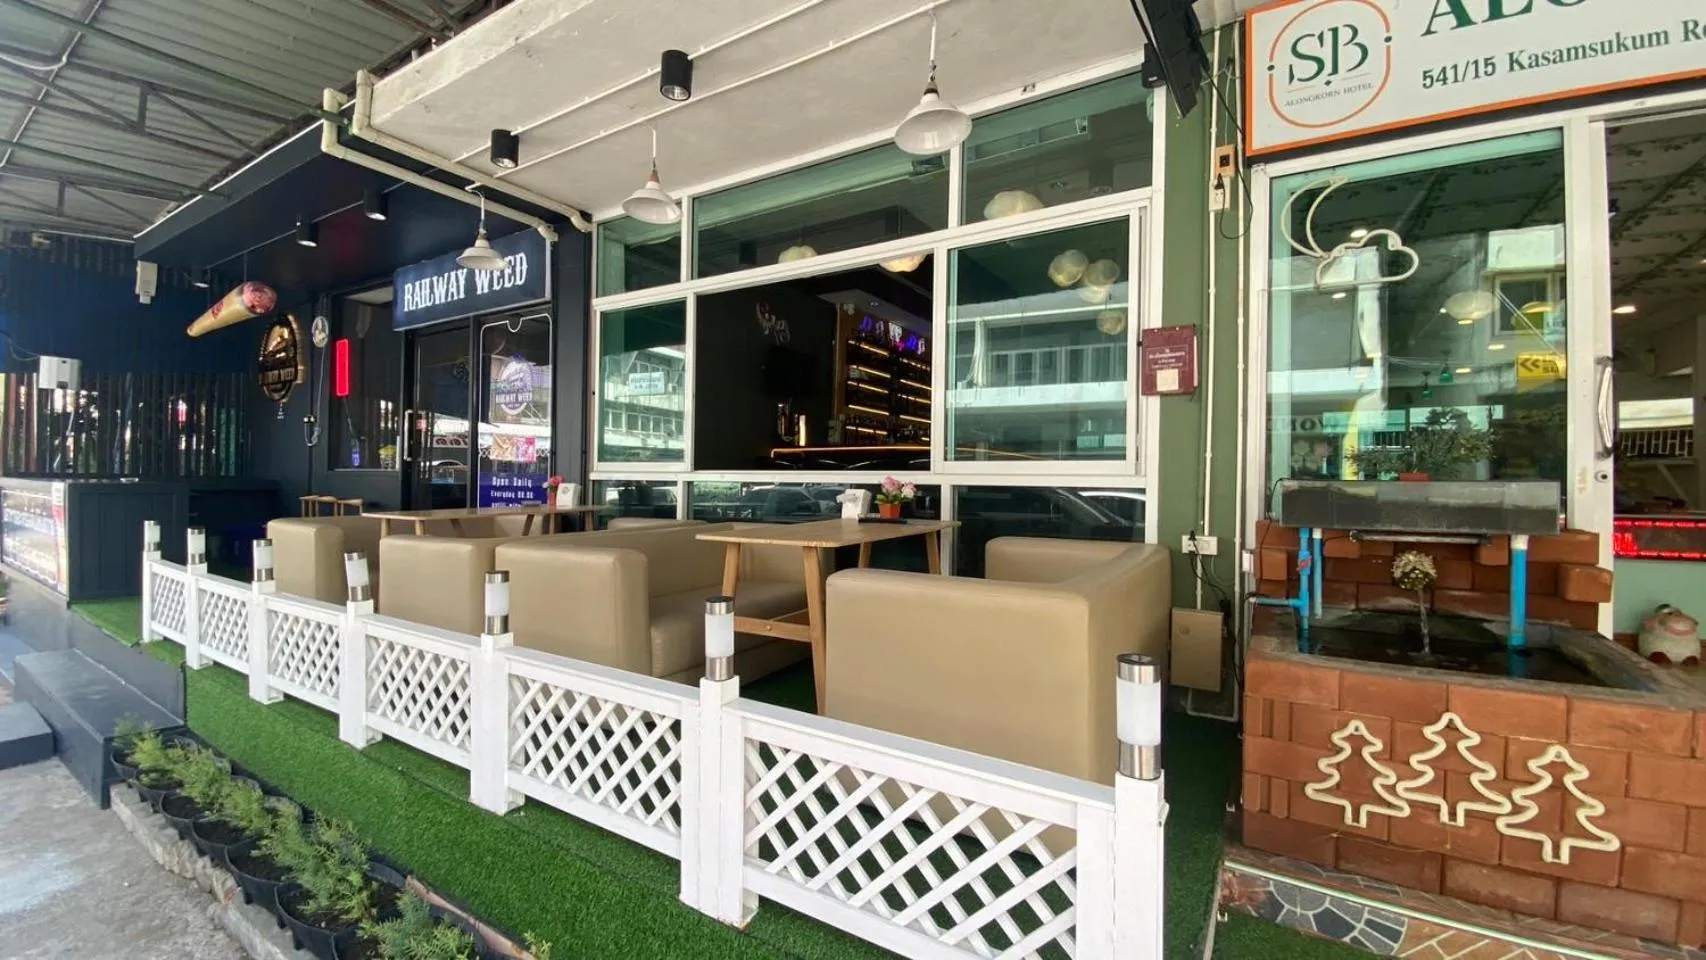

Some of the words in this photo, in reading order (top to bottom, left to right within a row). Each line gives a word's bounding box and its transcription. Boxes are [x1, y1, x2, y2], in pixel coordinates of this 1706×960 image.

[1422, 56, 1497, 89] 541/15
[1508, 28, 1670, 73] Kasamsukum
[1284, 89, 1341, 107] ALONGKORN
[1343, 82, 1374, 95] HOTEL
[403, 268, 467, 312] RAILWAY
[475, 252, 528, 295] WEED
[490, 490, 515, 499] Everyday
[492, 476, 509, 487] Open
[513, 477, 532, 488] Daily
